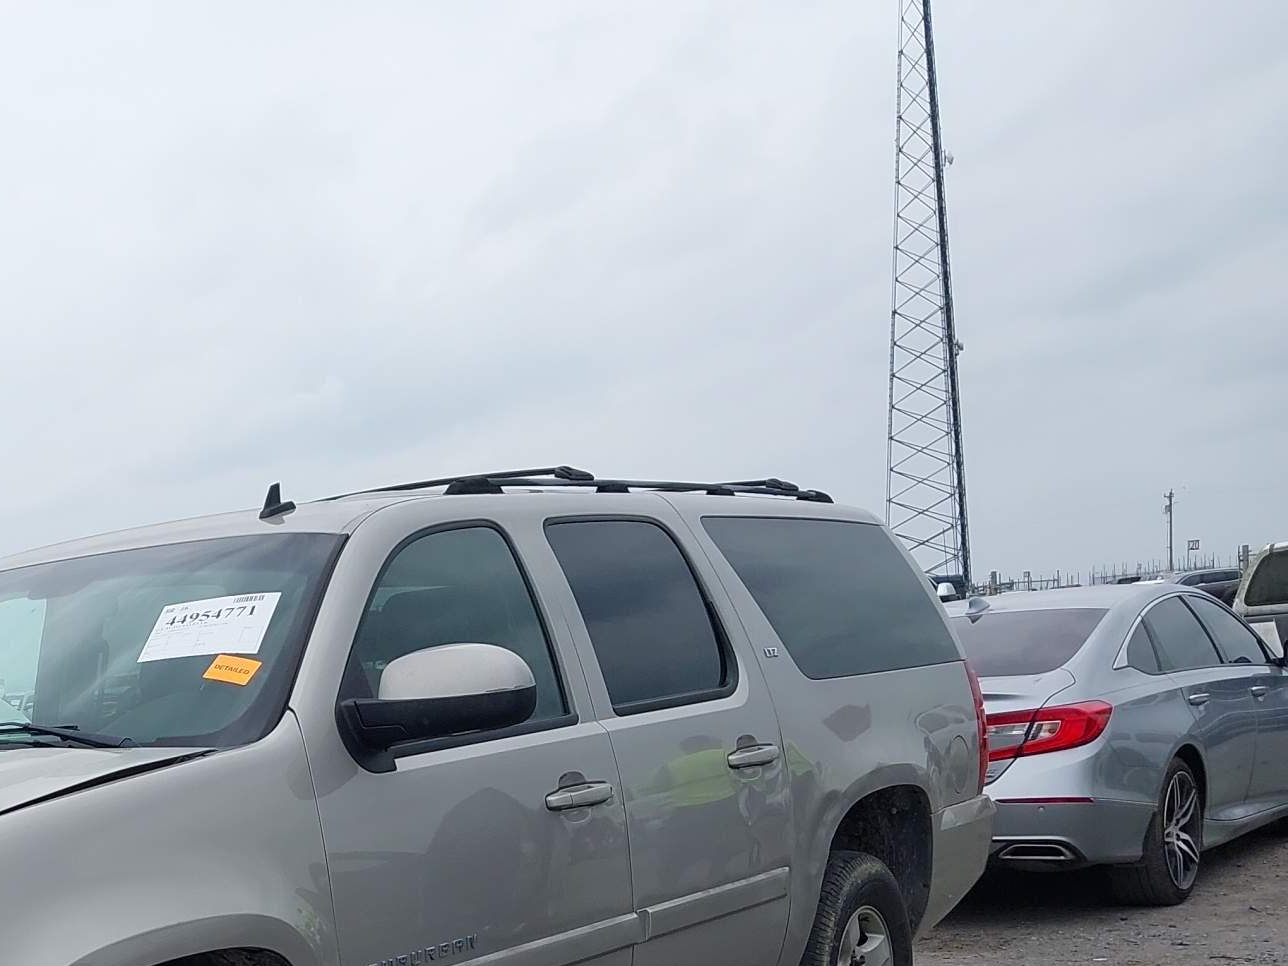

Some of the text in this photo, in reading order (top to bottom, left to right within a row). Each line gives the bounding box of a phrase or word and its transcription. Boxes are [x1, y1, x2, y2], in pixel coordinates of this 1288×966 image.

[165, 605, 256, 627] 44954771
[763, 647, 779, 657] LTZ
[214, 663, 250, 676] DETAILED
